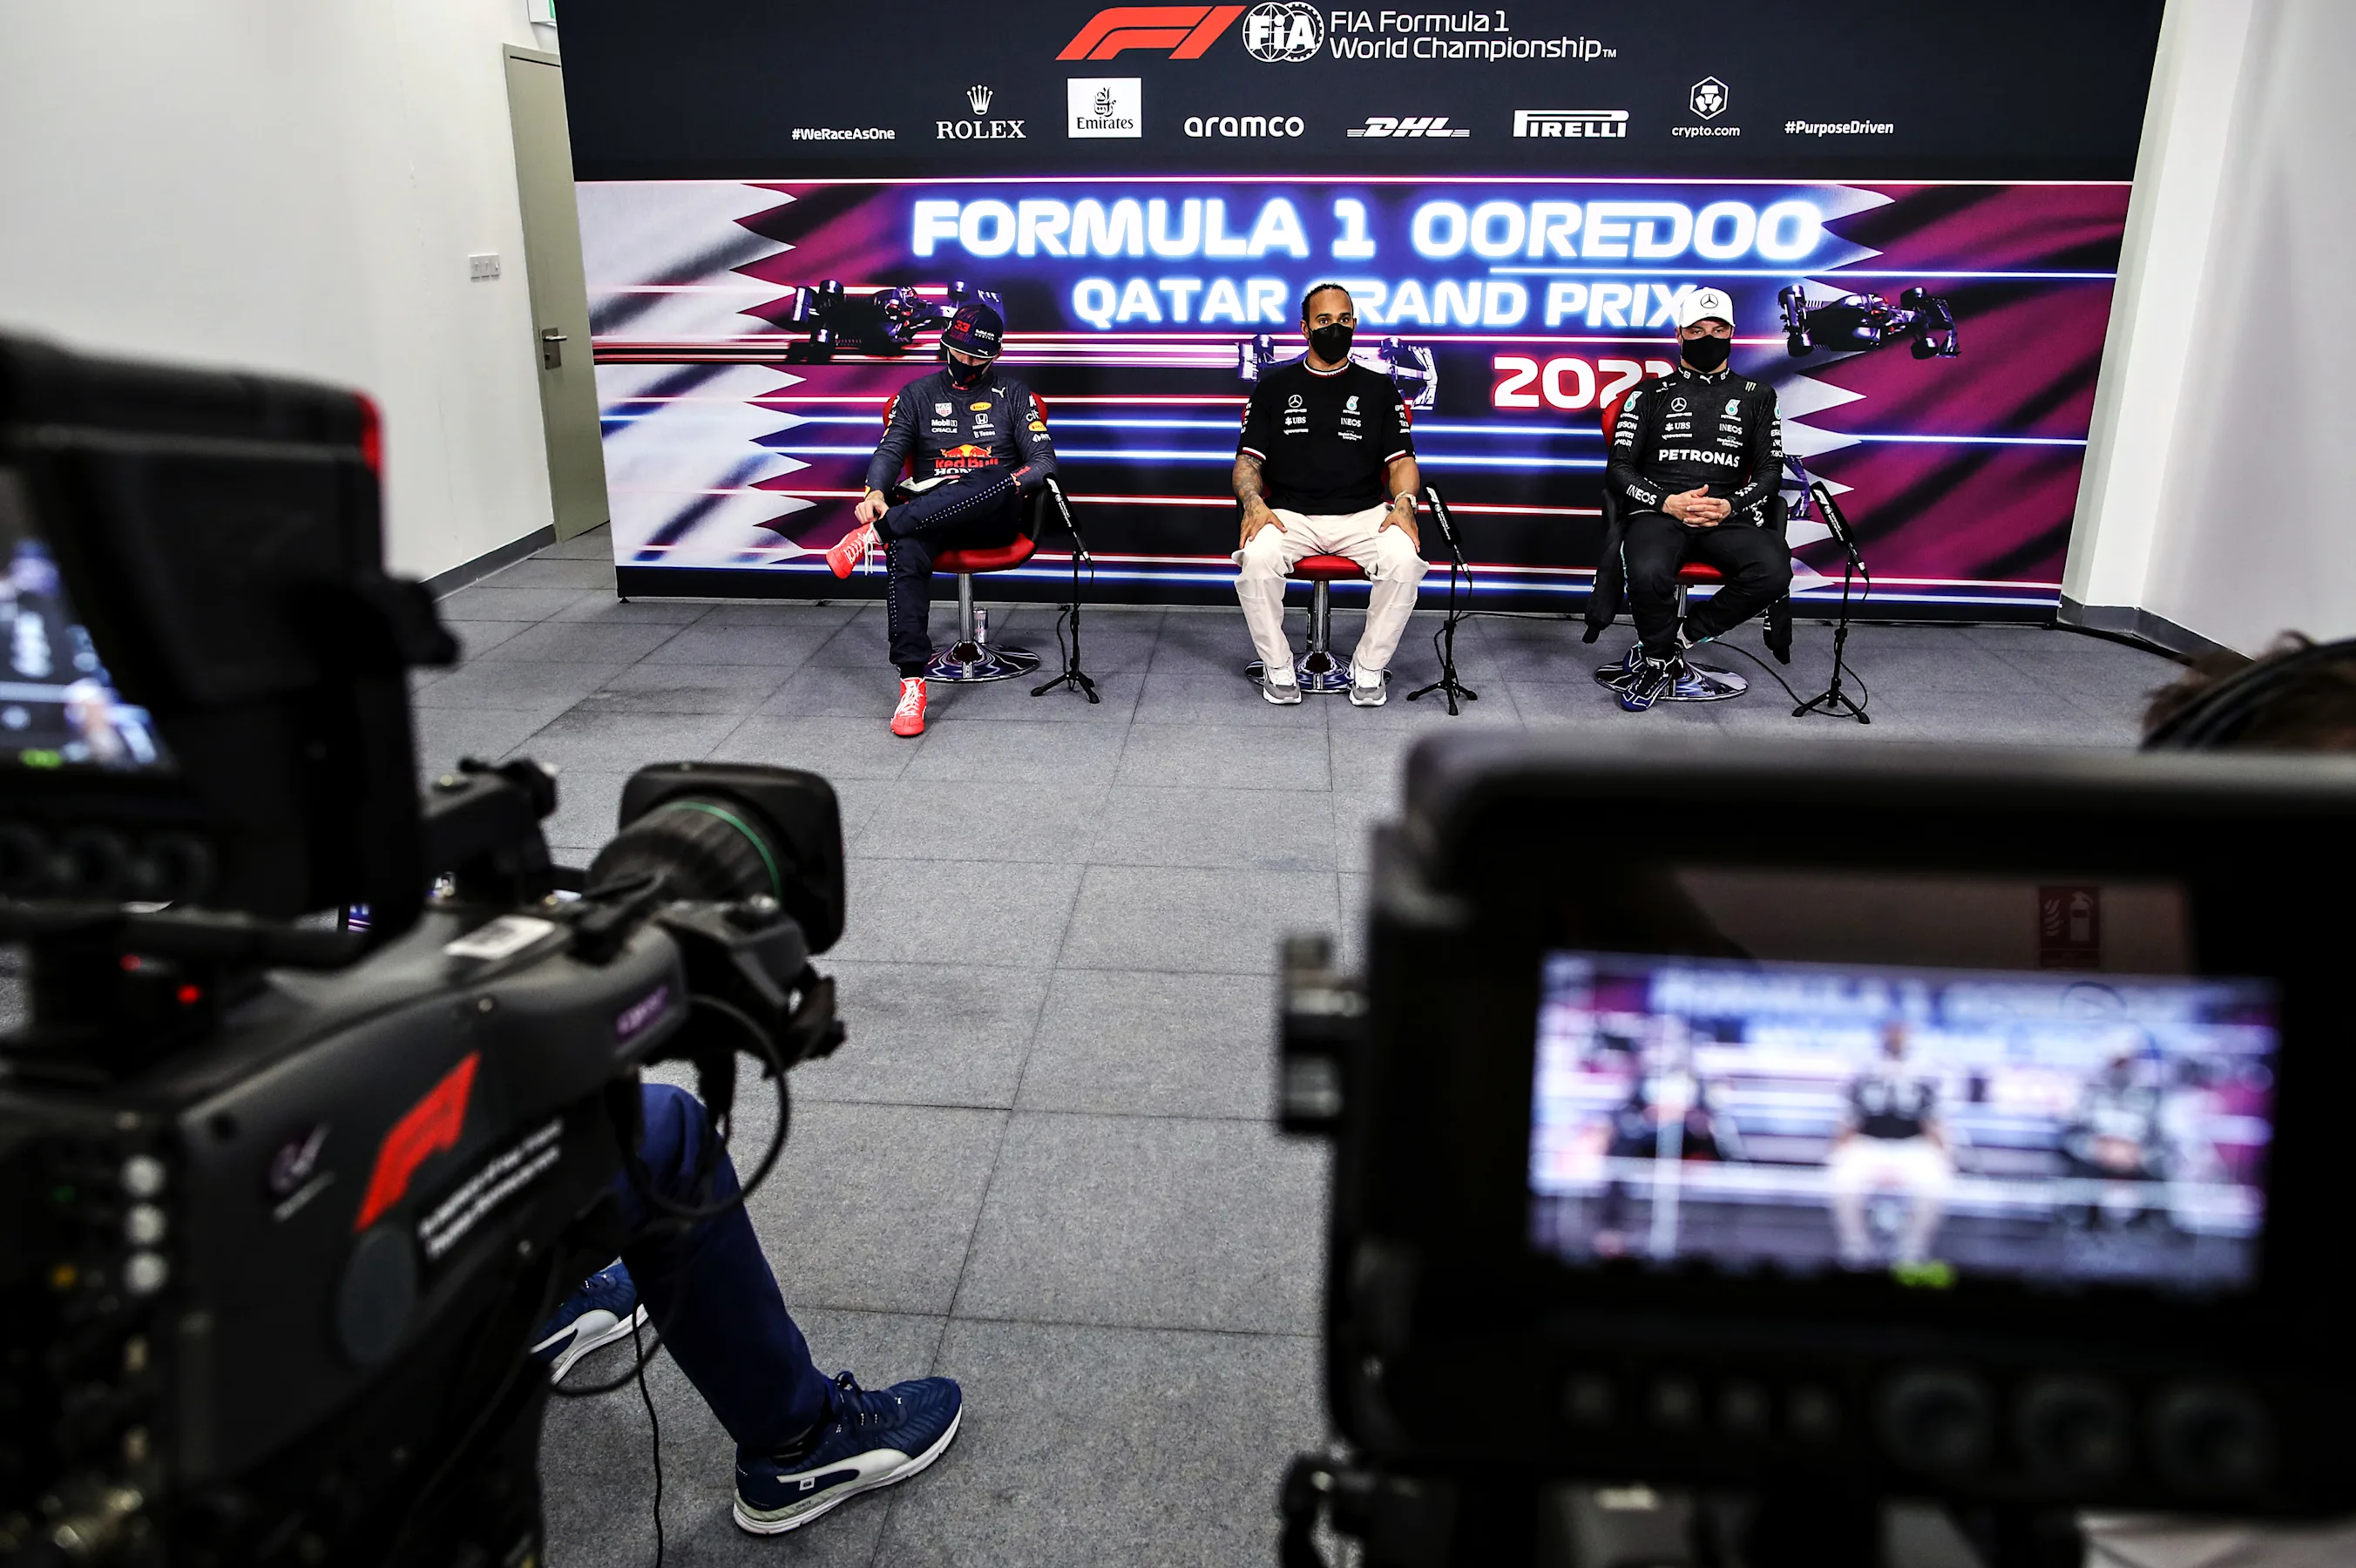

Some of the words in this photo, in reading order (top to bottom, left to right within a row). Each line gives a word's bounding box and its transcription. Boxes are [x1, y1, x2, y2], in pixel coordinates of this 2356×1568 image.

[1330, 10, 1374, 33] FIA
[1379, 10, 1490, 33] Formula
[1493, 10, 1510, 32] 1
[1330, 37, 1408, 59] World
[936, 120, 1026, 139] ROLEX
[1076, 117, 1134, 130] Emirates
[1183, 116, 1305, 138] aramco
[1363, 117, 1457, 138] DHL
[1513, 109, 1630, 138] PIRELLI
[1671, 125, 1741, 138] crypto.com
[1784, 120, 1894, 138] #PurposeDriven
[791, 127, 896, 140] #WeRaceAsOne
[913, 199, 1307, 258] FORMULA
[1332, 199, 1376, 258] 1
[1412, 200, 1823, 260] OOREDOO
[1073, 278, 1287, 328] QATAR
[1305, 280, 1527, 326] RAND
[955, 320, 971, 333] 33
[1340, 417, 1362, 427] INEOS
[1719, 423, 1743, 435] INEOS
[1659, 449, 1740, 468] PETRONAS
[1626, 484, 1657, 505] INEOS
